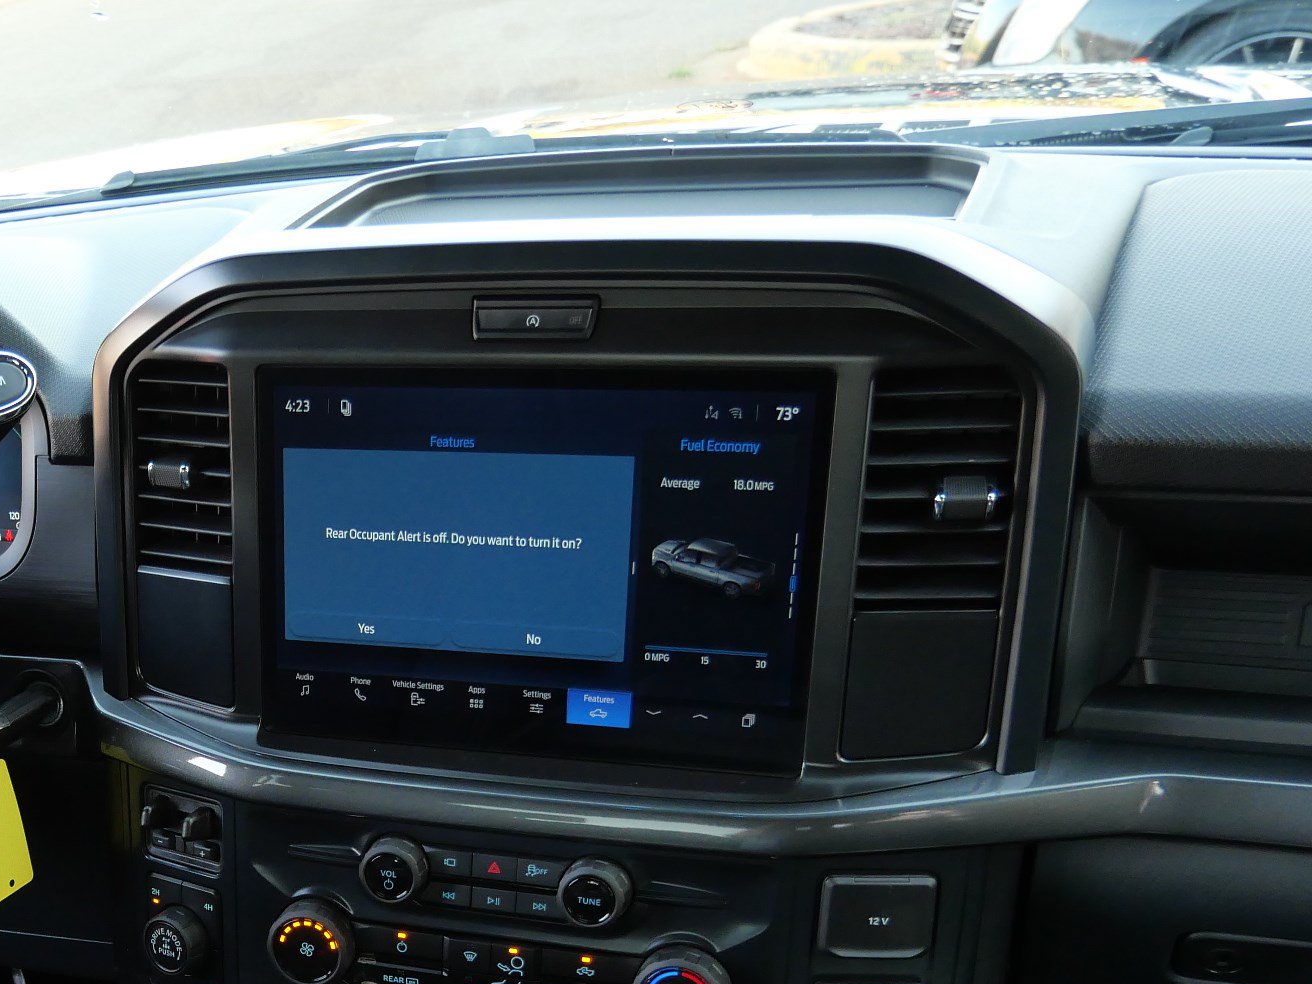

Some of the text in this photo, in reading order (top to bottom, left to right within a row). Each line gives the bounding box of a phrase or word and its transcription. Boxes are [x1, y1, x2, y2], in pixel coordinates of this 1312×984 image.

[285, 399, 311, 413] 4:23
[429, 435, 476, 449] Features
[680, 439, 761, 456] Fuel Economy
[660, 477, 701, 491] Average
[325, 527, 583, 550] Rear Occupant Alert is off. Do you want to turn it on?
[357, 622, 375, 635] Yes
[525, 633, 542, 646] No
[644, 652, 670, 663] 0 MPG
[700, 656, 709, 665] 15
[755, 660, 767, 669] 30
[295, 672, 315, 682] Audio
[350, 676, 372, 687] Phone
[392, 680, 445, 692] Vehicle Settings
[468, 685, 486, 695] Apps
[522, 689, 552, 700] Settings
[583, 694, 615, 705] Features
[380, 869, 397, 879] VOL
[536, 868, 548, 876] OFF
[151, 887, 160, 896] 2H
[577, 896, 601, 907] TUNE
[203, 903, 213, 912] 4H
[868, 916, 889, 926] 12 V
[150, 927, 183, 952] DRIVE MODE
[158, 947, 175, 958] PUSH
[383, 974, 405, 984] REAR
